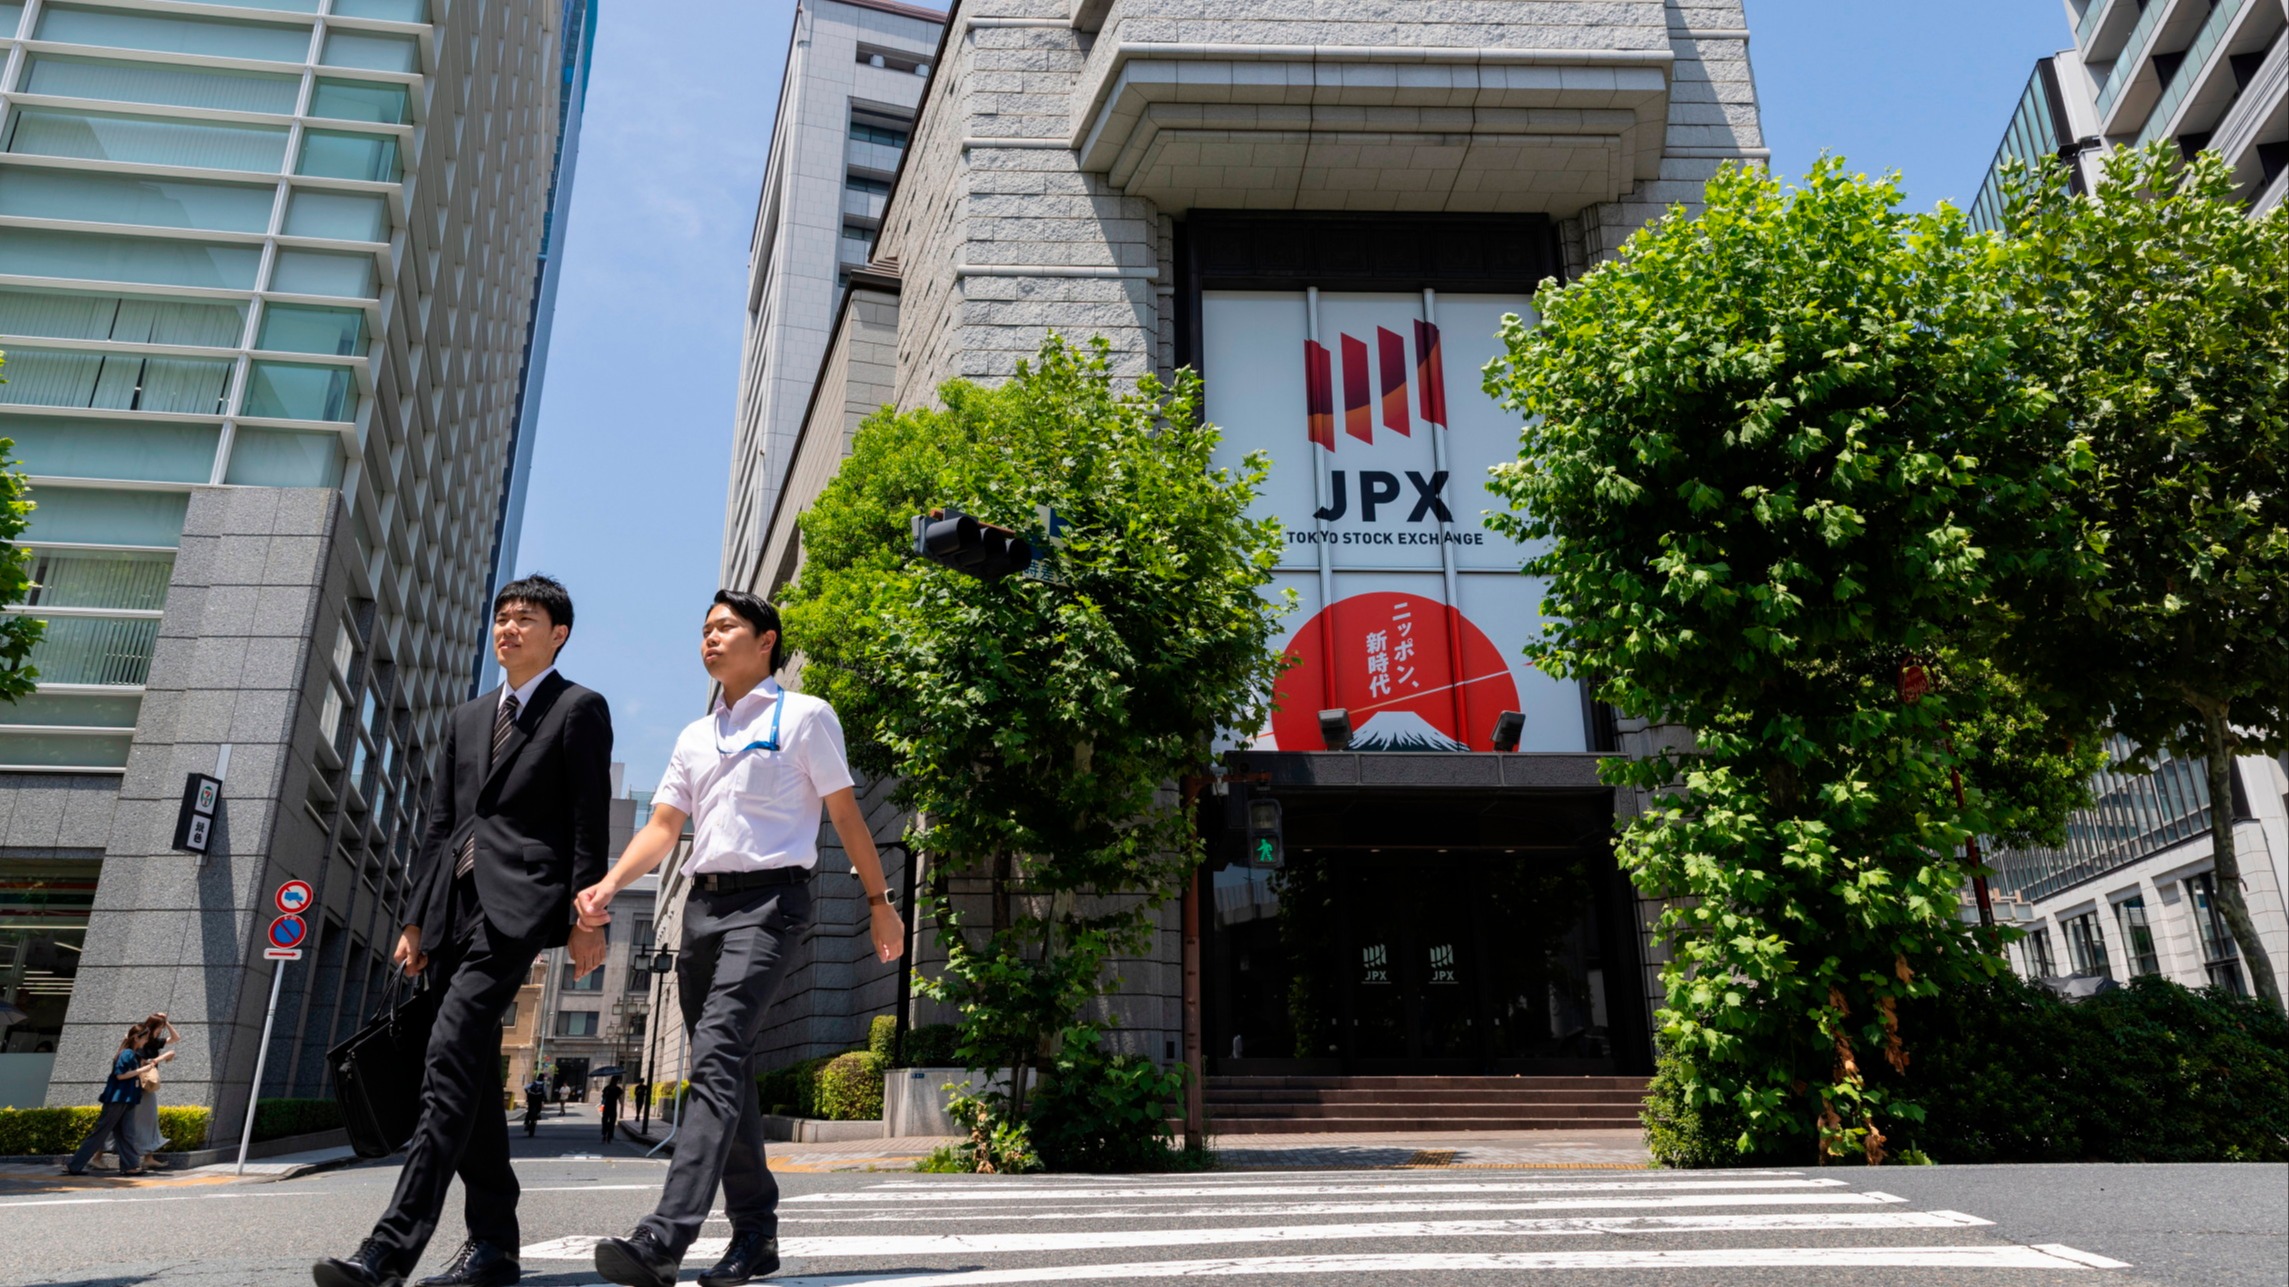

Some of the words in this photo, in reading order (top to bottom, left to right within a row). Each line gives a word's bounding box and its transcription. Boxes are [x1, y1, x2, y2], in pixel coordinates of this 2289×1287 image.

[1312, 470, 1454, 523] JPX
[1287, 530, 1338, 545] TOKYO
[1343, 532, 1393, 545] STOCK
[1398, 531, 1484, 546] EXCHANGE
[1366, 629, 1391, 698] 新時代
[1365, 970, 1387, 981] JPX
[1432, 970, 1455, 981] JPX
